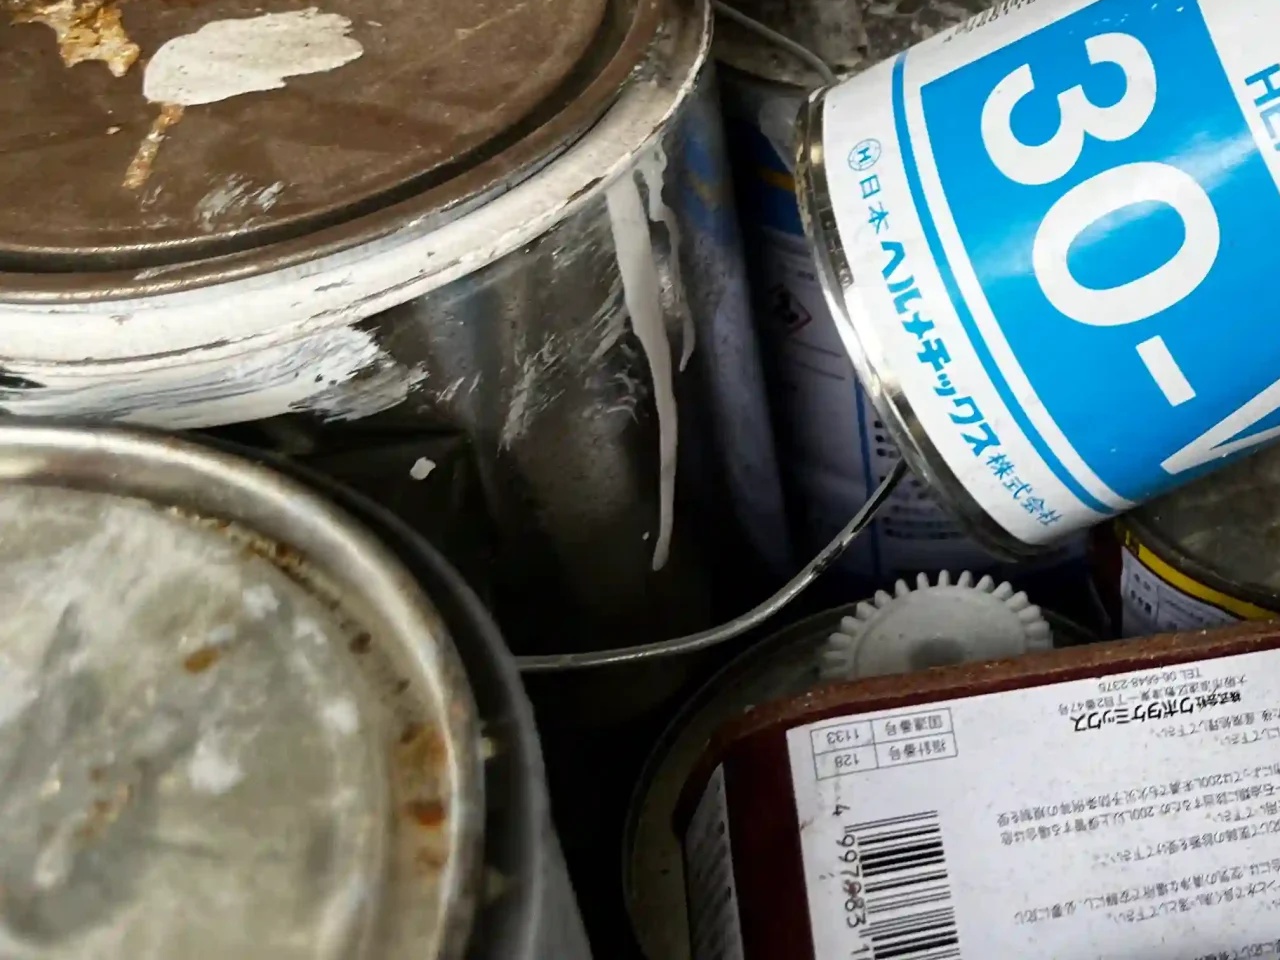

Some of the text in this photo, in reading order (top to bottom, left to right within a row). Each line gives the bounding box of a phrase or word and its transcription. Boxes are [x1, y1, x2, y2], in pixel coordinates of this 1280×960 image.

[824, 725, 860, 744] 1133
[832, 751, 860, 770] 128
[832, 803, 851, 817] 4
